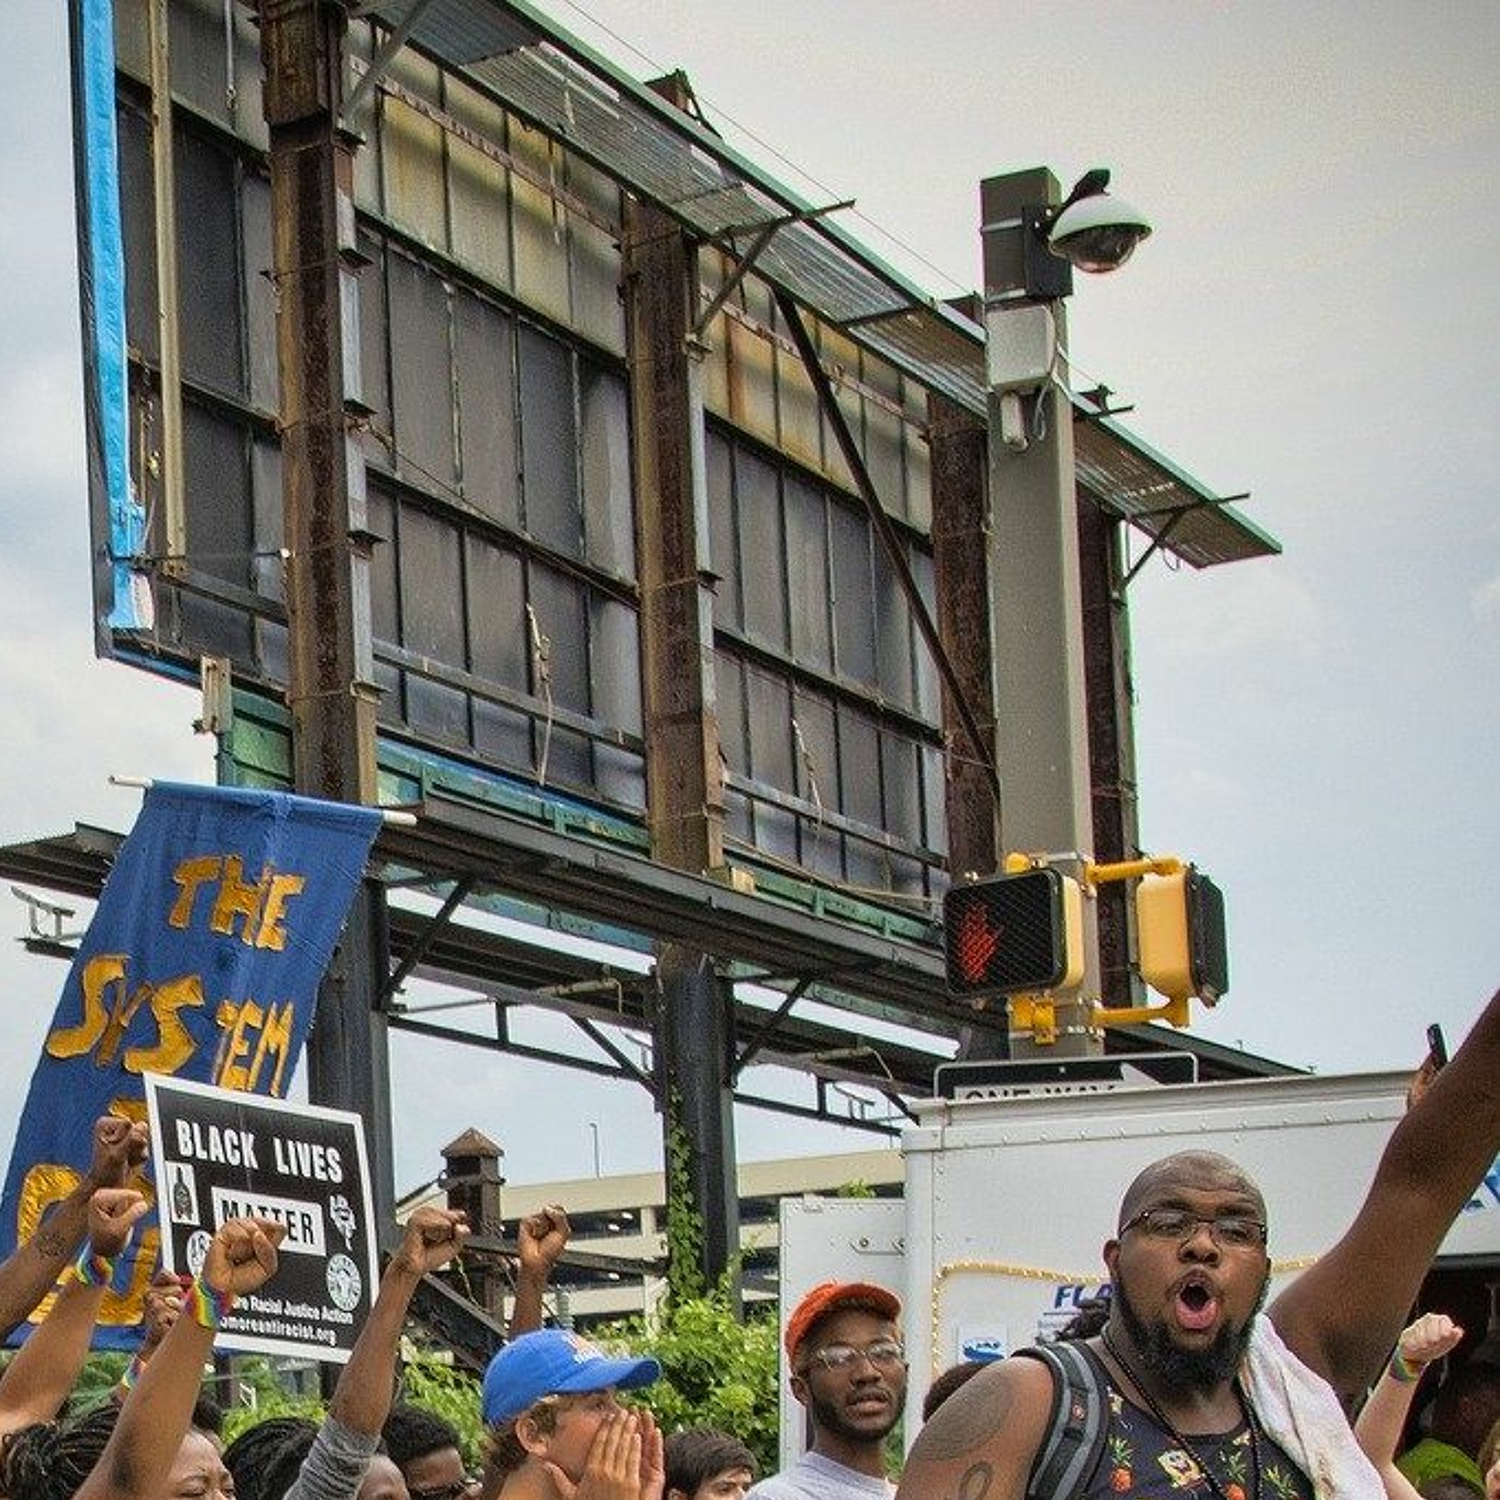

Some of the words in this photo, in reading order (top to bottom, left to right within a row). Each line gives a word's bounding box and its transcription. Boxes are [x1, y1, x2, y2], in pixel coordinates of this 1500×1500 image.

[168, 853, 306, 951] THE
[46, 953, 294, 1098] SYSTEM
[176, 1118, 259, 1170] BLACK
[273, 1136, 344, 1184] LIVES
[250, 1295, 282, 1315] Racial
[284, 1300, 320, 1320] Justice
[321, 1305, 353, 1325] Action
